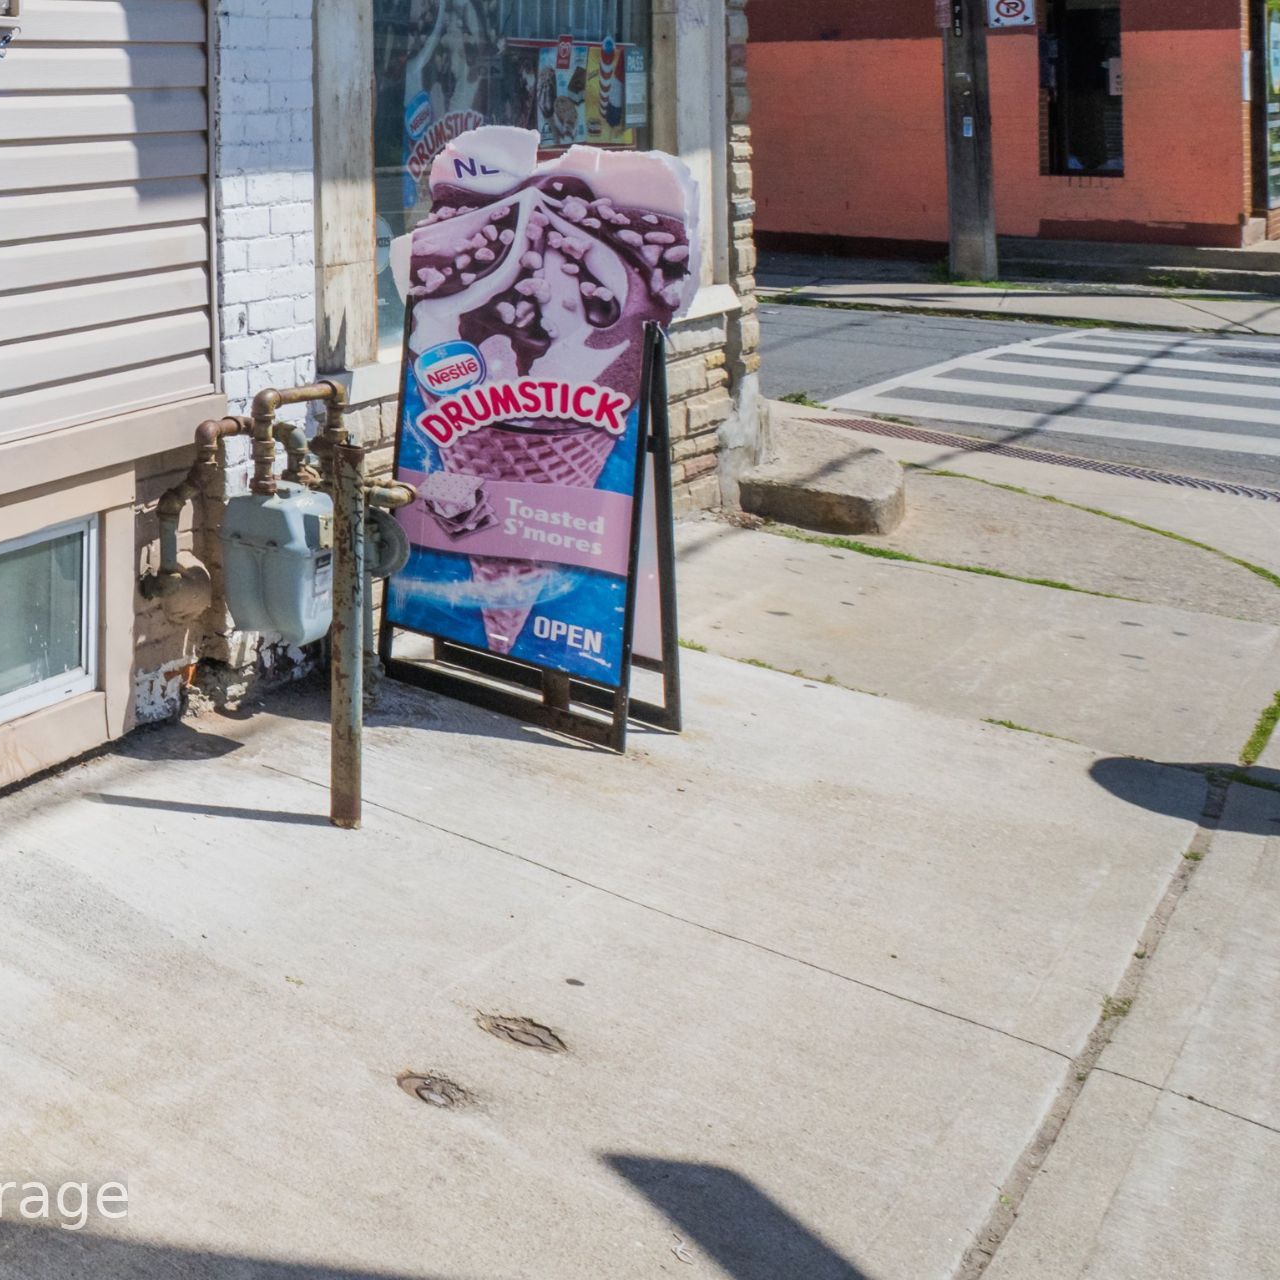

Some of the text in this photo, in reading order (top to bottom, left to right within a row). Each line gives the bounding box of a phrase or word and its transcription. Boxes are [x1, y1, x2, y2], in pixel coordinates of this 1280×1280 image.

[419, 380, 625, 445] DRUMSTICK
[505, 497, 606, 535] Toasted
[503, 518, 603, 556] S'mores
[533, 615, 603, 654] OPEN
